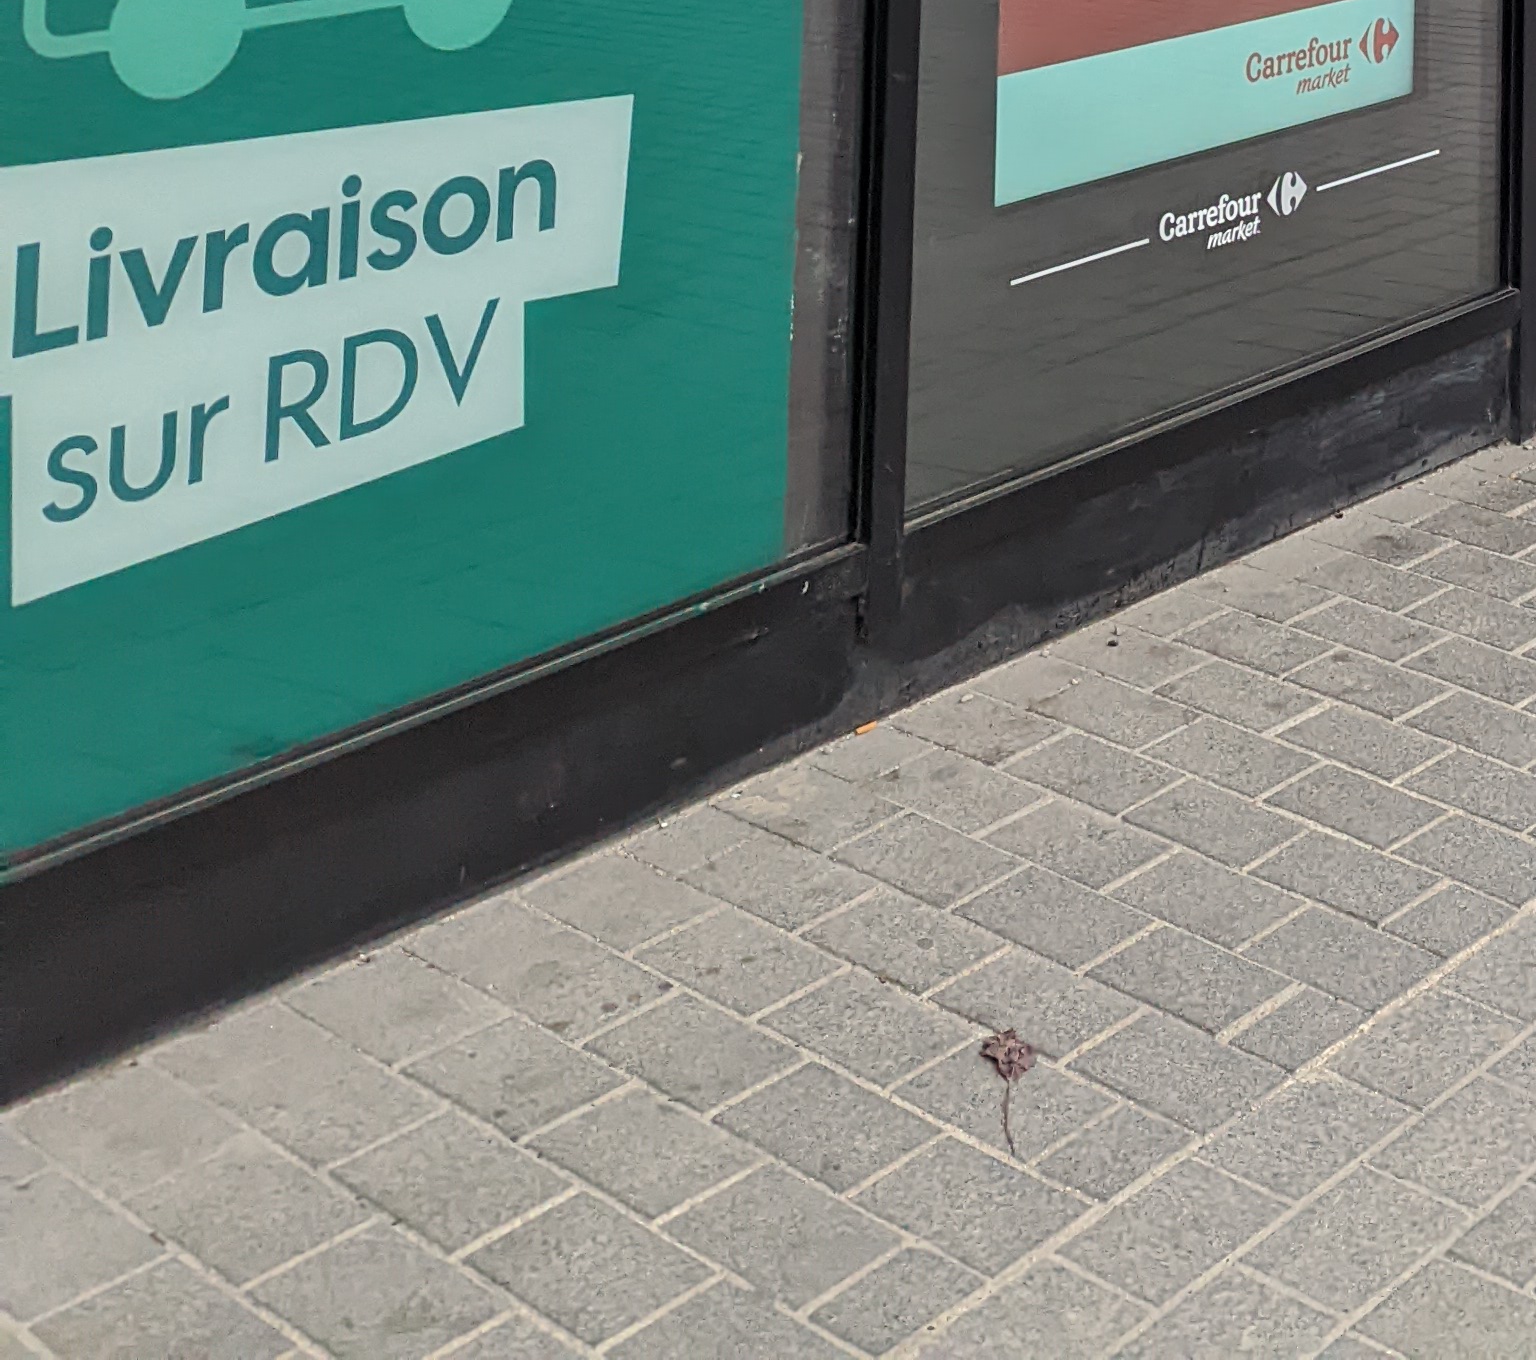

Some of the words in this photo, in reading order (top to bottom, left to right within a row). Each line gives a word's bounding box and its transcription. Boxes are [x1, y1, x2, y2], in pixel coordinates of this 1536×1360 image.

[1244, 35, 1353, 84] Carrefour
[1296, 63, 1351, 96] market
[1158, 192, 1262, 242] Carrefour
[1206, 217, 1260, 251] market
[12, 158, 558, 359] Livraison
[42, 394, 231, 524] sur
[264, 296, 501, 464] RDV
